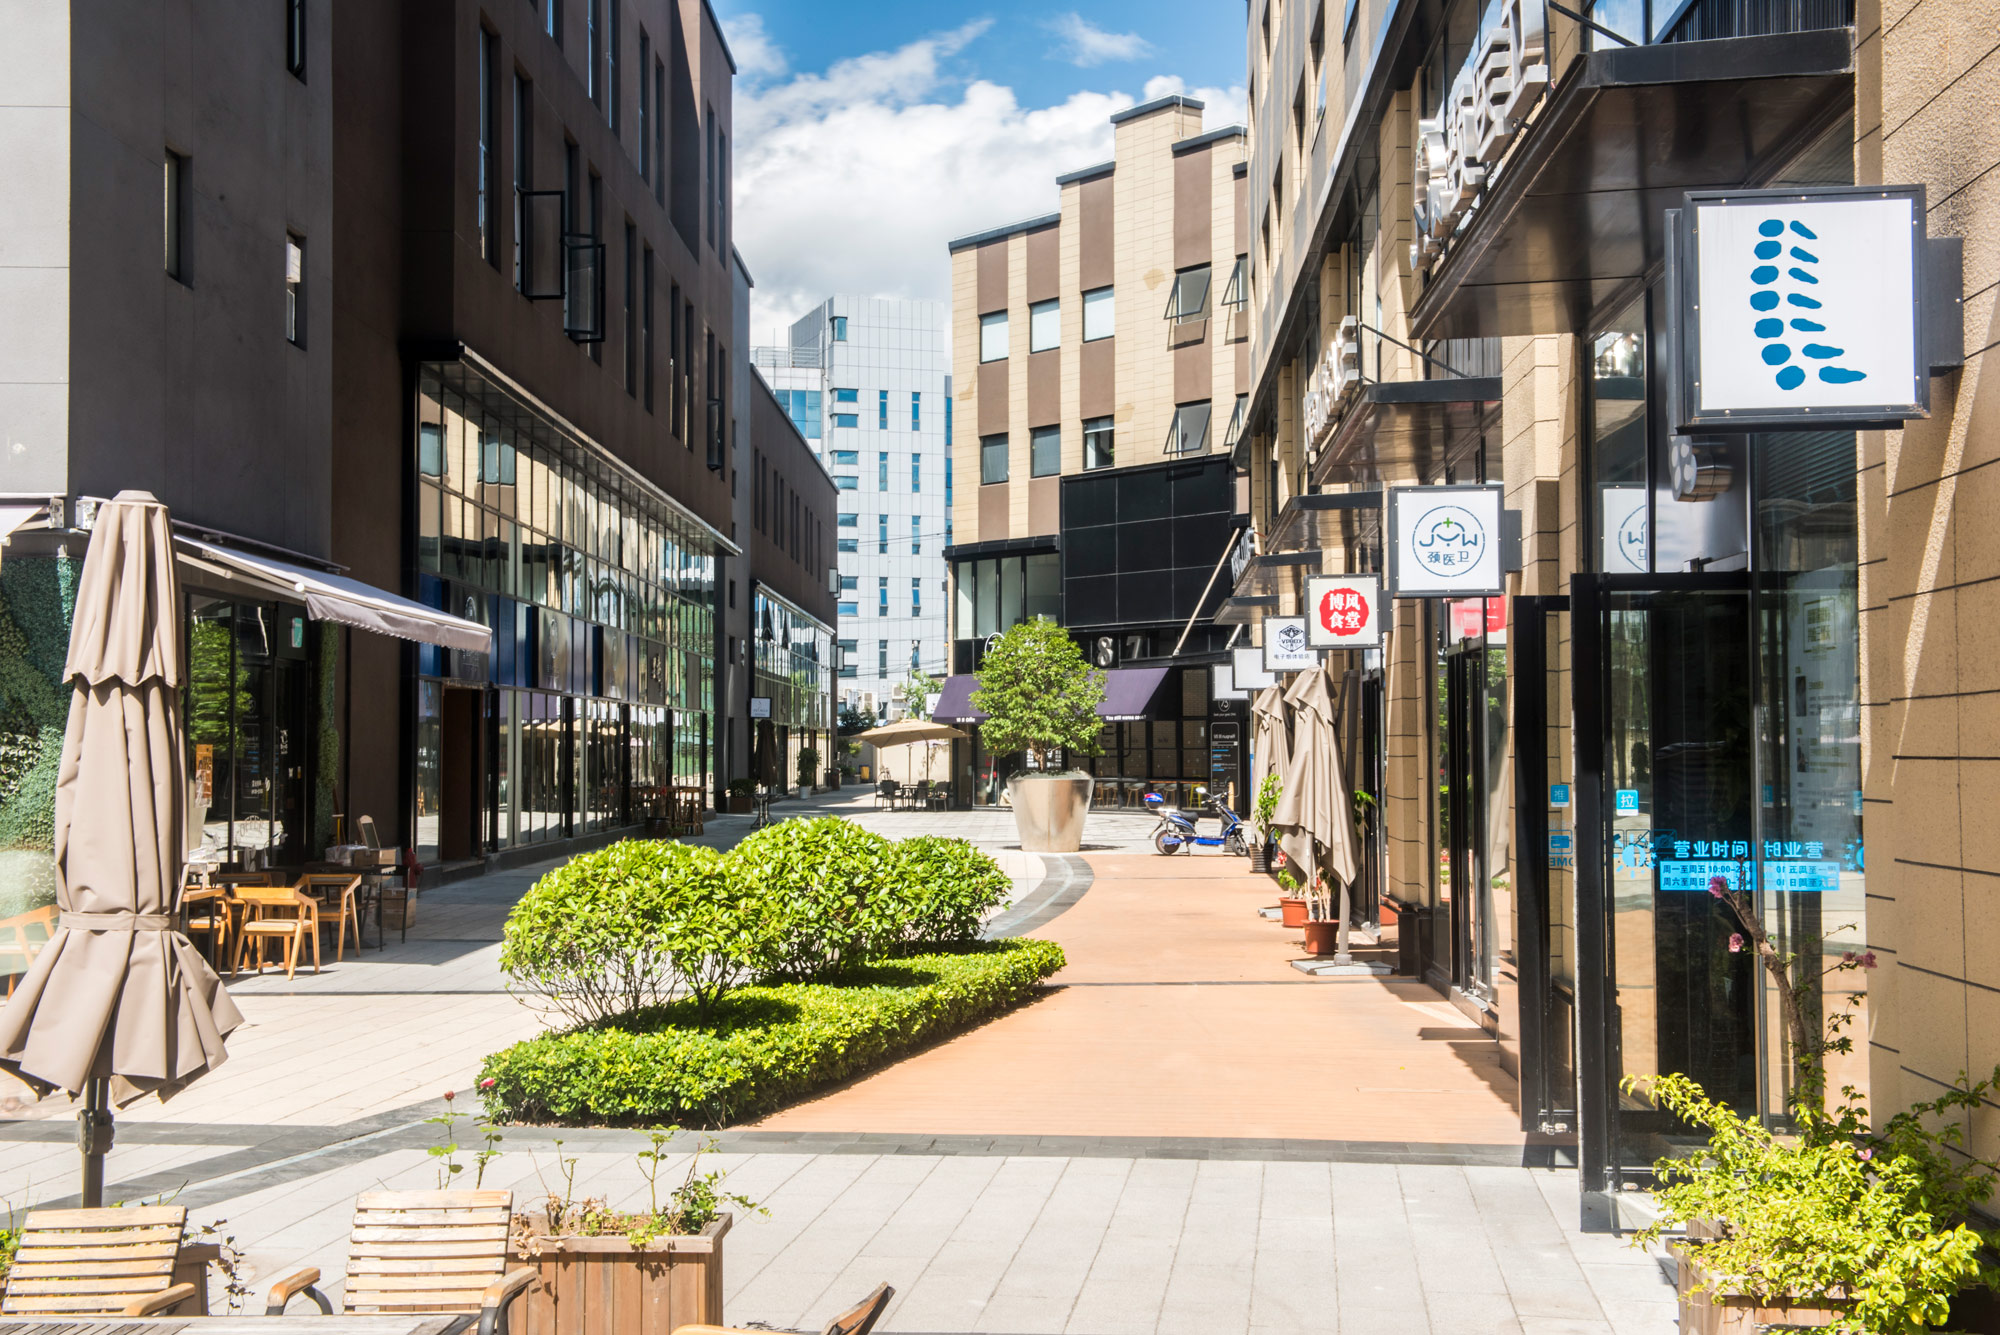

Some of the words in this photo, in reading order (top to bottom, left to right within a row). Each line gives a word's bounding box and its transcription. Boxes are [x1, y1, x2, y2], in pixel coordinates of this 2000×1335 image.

[1427, 551, 1470, 566] 颈医卫
[1329, 593, 1361, 610] 博风
[1329, 611, 1361, 628] 食堂
[1620, 793, 1635, 808] 拉
[1673, 840, 1749, 859] 营业时间
[1662, 864, 1706, 874] 周一至周五
[1662, 877, 1706, 887] 周六至周日
